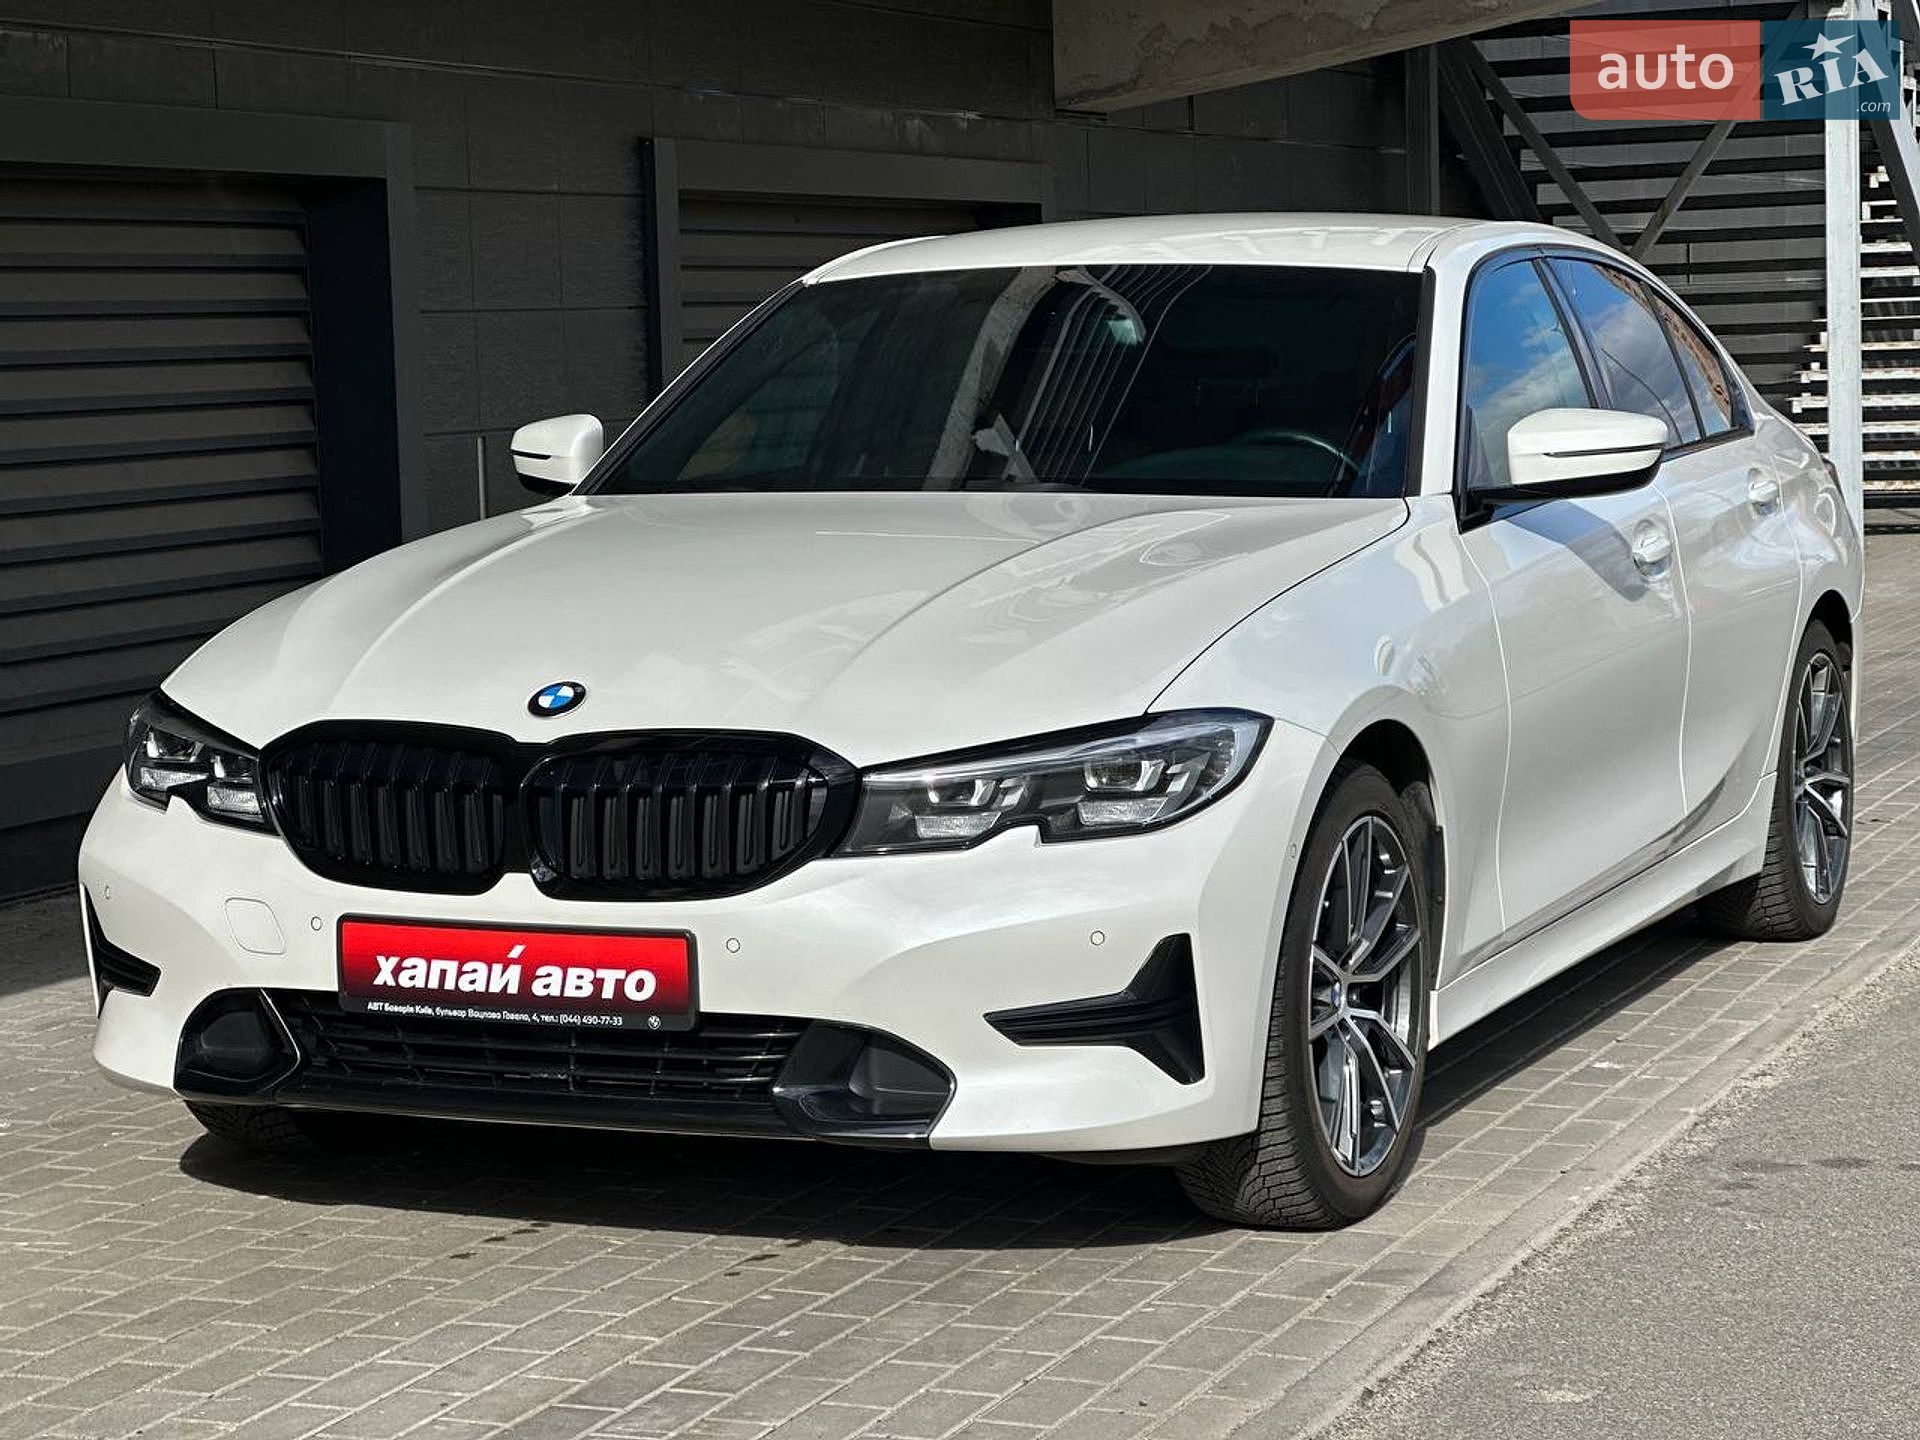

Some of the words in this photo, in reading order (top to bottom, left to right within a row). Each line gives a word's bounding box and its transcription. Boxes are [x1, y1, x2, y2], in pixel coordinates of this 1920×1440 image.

[373, 945, 527, 995] хапай
[531, 964, 657, 1002] авто
[560, 1014, 581, 1025] (044)
[582, 1014, 623, 1026] 490-77-33
